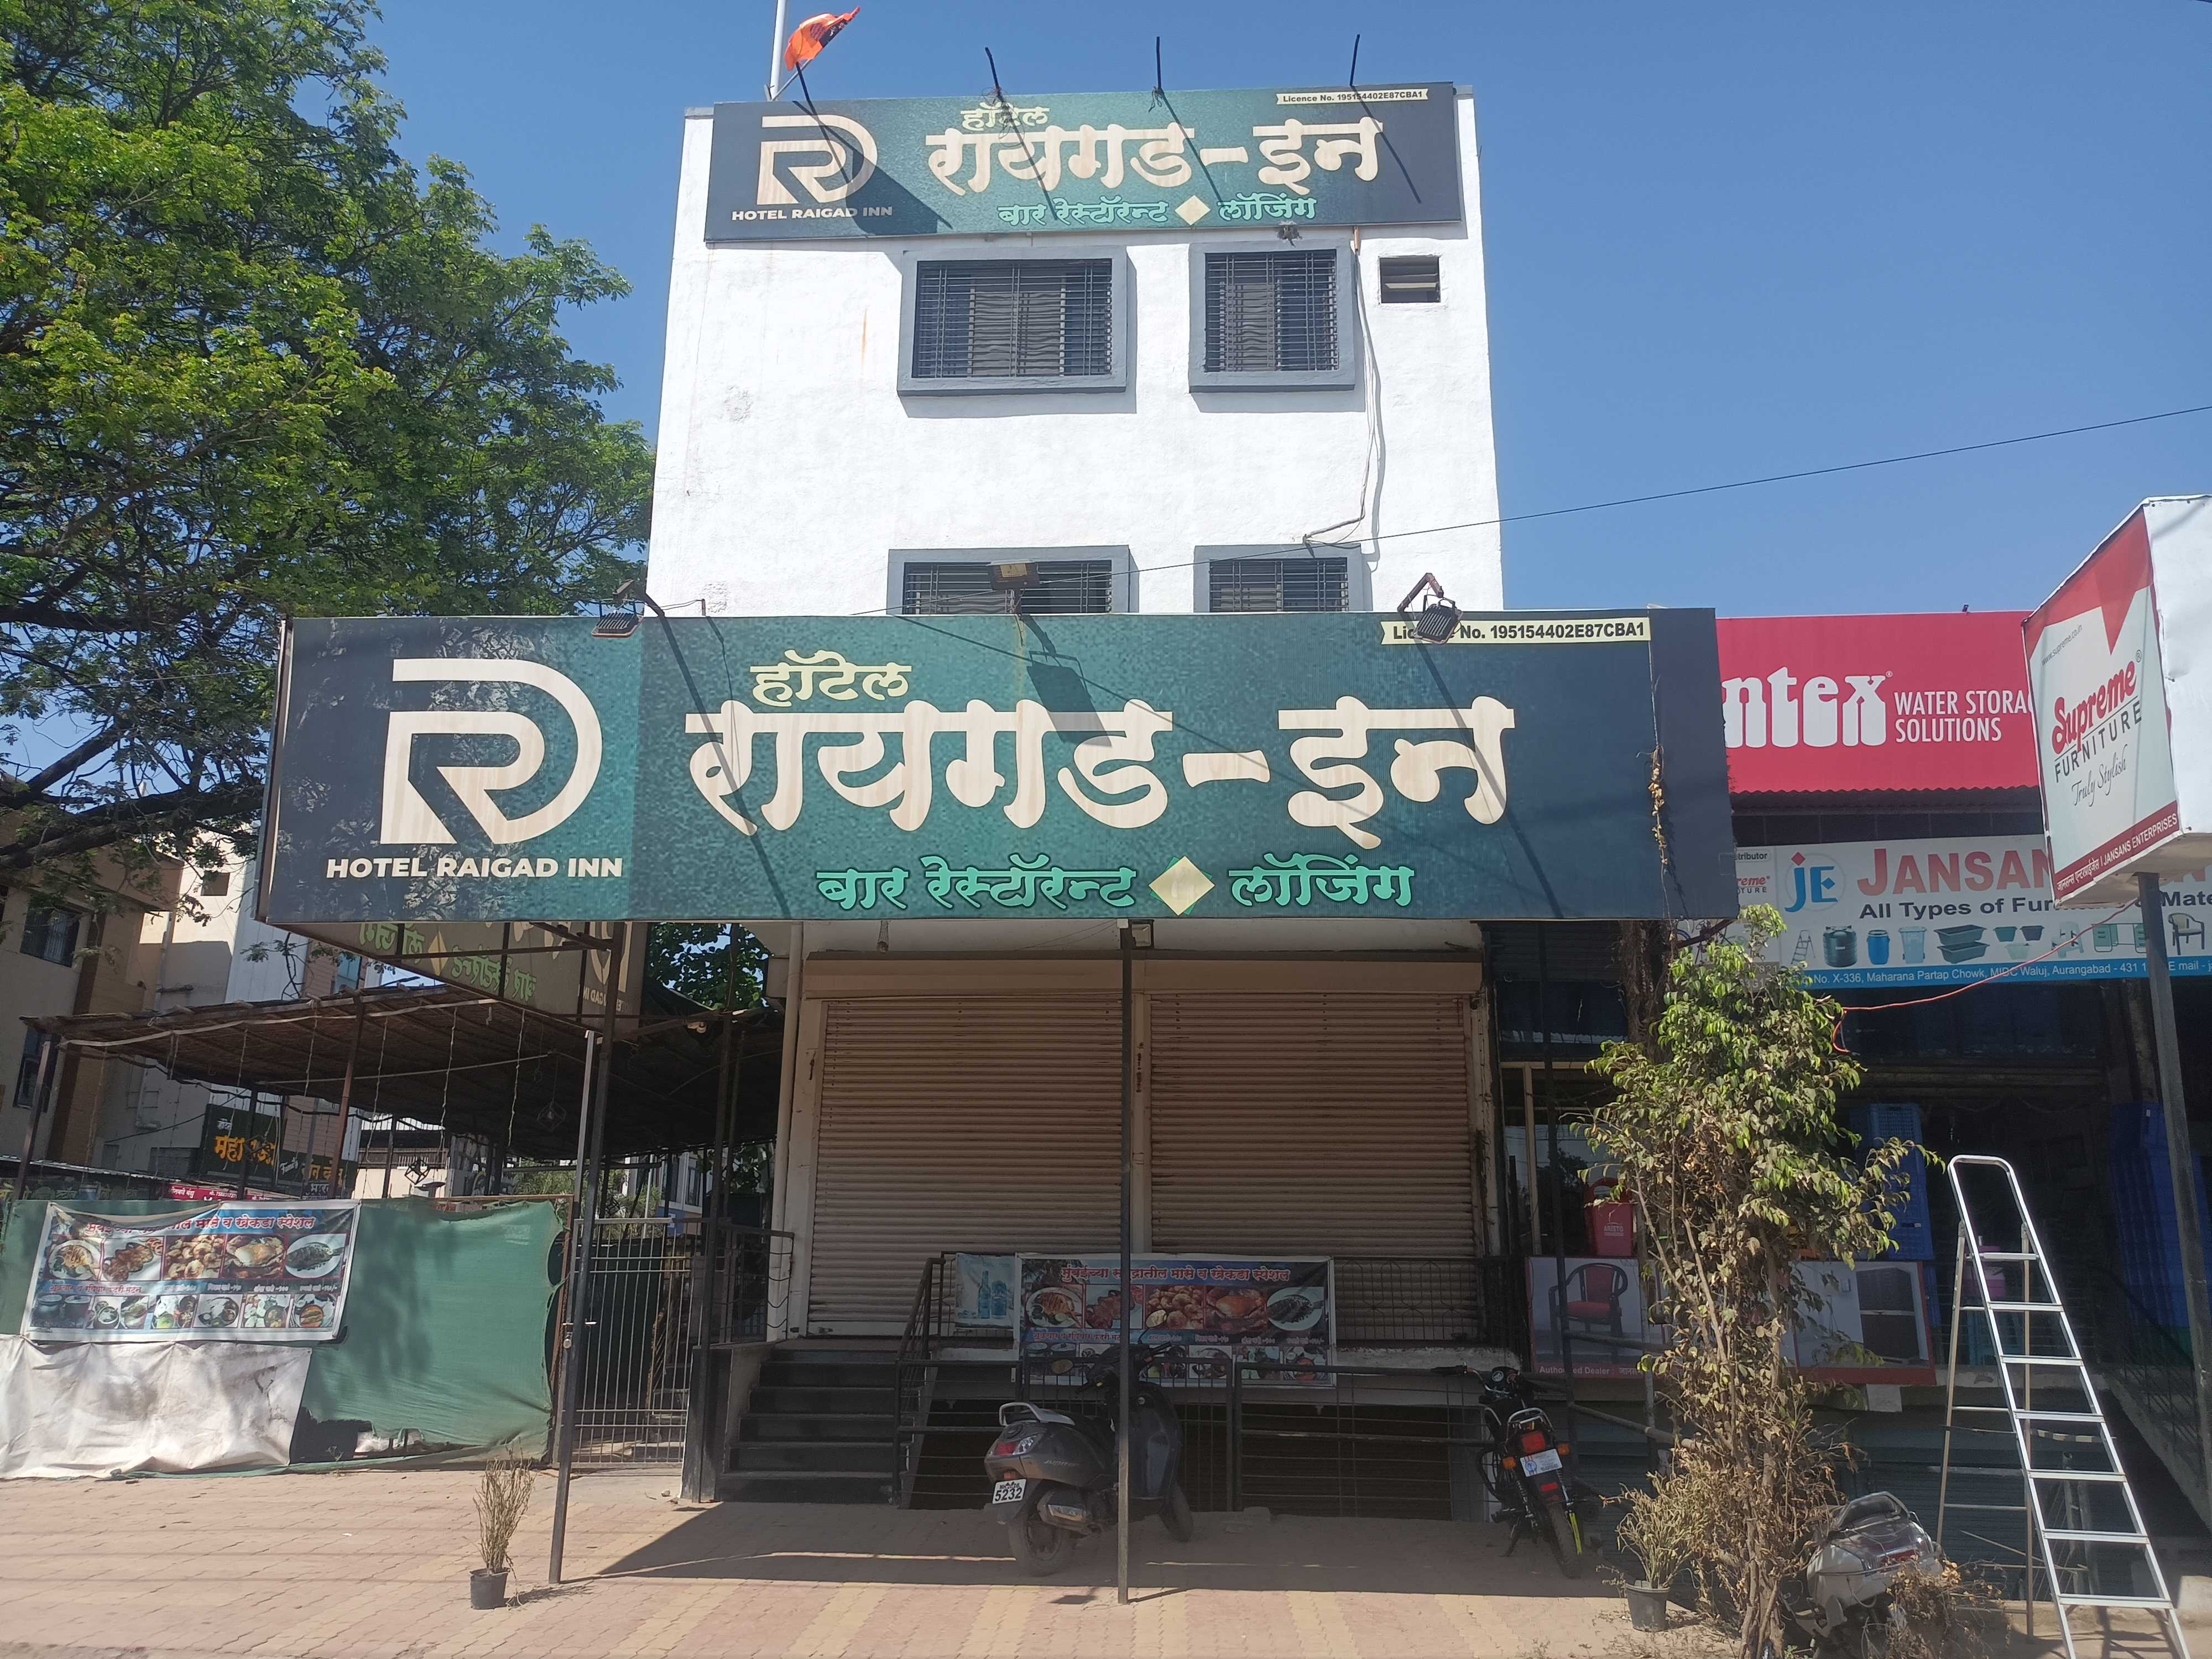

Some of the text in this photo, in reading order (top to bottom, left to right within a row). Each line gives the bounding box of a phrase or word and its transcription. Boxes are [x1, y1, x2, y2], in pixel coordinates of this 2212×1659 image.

[1337, 91, 1422, 101] 195154402E87CBA1
[732, 206, 893, 221] HOTEL RAIGAD INN
[998, 204, 1045, 226] बार
[1217, 192, 1317, 221] लॉजिंग
[1393, 622, 1645, 639] Lice No. 195154402E87CBA1
[2041, 624, 2083, 666] www.supreme.co.in
[750, 649, 912, 707] हॉटेल
[1893, 691, 1958, 715] WATER
[2052, 660, 2137, 755] Supreme
[1895, 717, 2002, 743] SOLUTIONS
[2054, 700, 2142, 783] FURNITURE
[2072, 744, 2127, 807] Truly Stylish
[2103, 813, 2178, 867] JANSANS ENTERPRISES
[326, 857, 623, 878] HOTEL RAIGAD INN
[816, 852, 1416, 910] बार रेस्टॉरन्ट लॉजिंग
[1736, 876, 1766, 886] reme
[1859, 903, 1891, 919] All
[1898, 902, 1972, 921] Types
[1980, 898, 2005, 914] of
[1813, 974, 1830, 984] No.
[1833, 973, 1864, 984] X-336,
[1867, 971, 1915, 982] Maharana
[1918, 969, 1949, 982] Partap
[1952, 967, 1987, 979] Chowk,
[1990, 966, 2017, 978] MIDC
[2052, 962, 2111, 977] Aurangabad
[2120, 962, 2138, 972] 431
[2168, 961, 2175, 971] E
[2178, 960, 2199, 971] mail
[277, 1215, 316, 1230] स्पेशल
[1113, 1265, 1168, 1282] सद्रातील
[1170, 1265, 1195, 1280] मासे
[1198, 1267, 1208, 1281] व
[1211, 1265, 1250, 1281] खेकडा
[1253, 1265, 1290, 1282] स्पेशल
[1540, 1365, 1583, 1374] Authored
[1585, 1366, 1609, 1375] Dealer
[994, 1486, 1022, 1501] 5232
